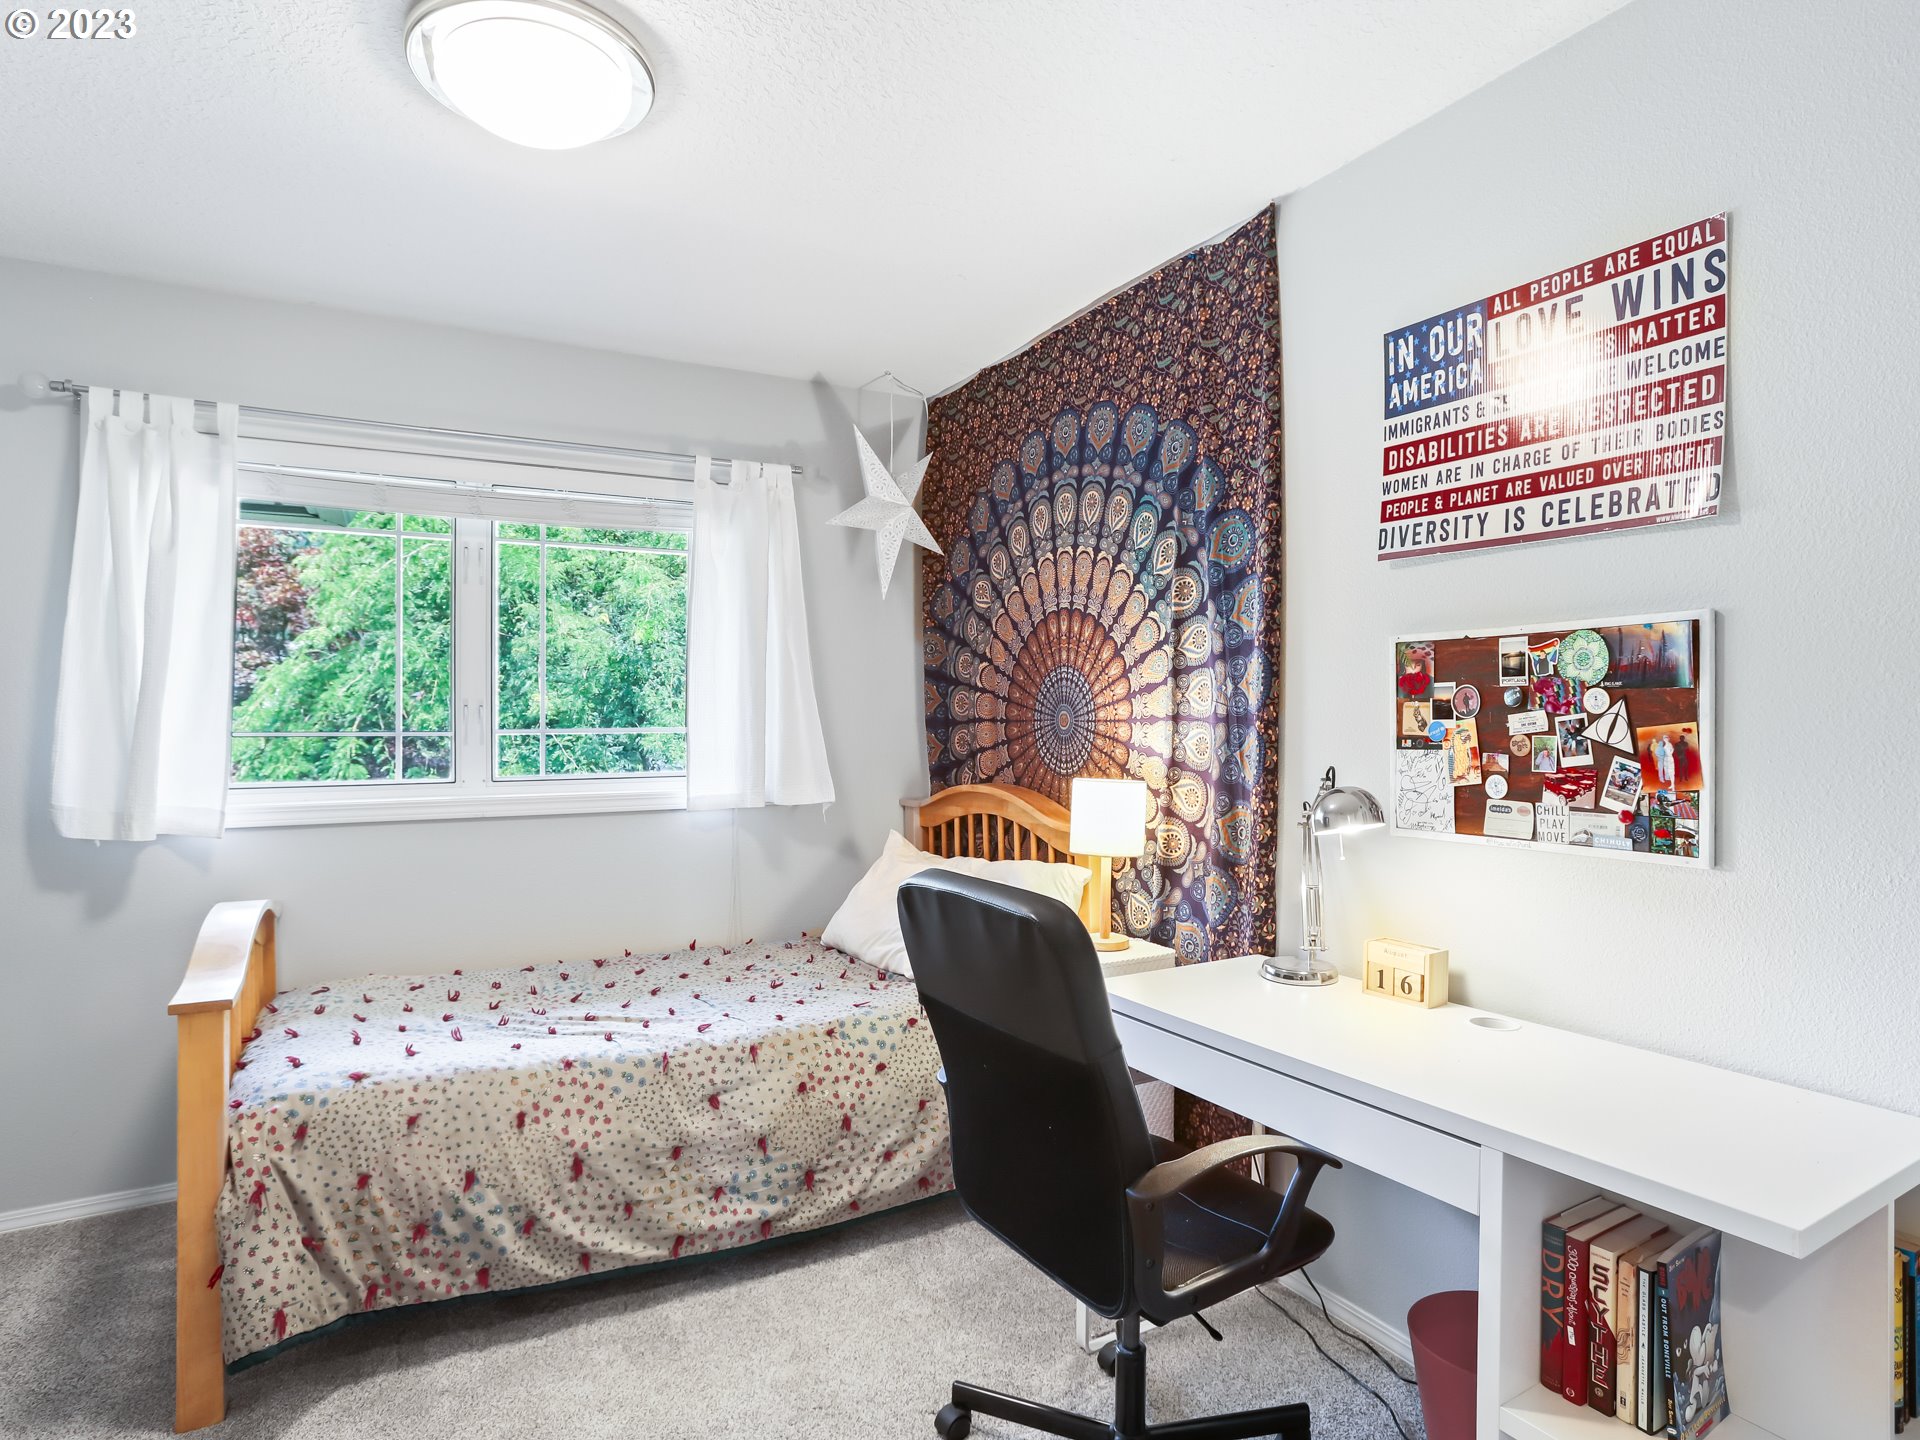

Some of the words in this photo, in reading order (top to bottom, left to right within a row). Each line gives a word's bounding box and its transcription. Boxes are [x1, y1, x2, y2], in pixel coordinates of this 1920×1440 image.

[1493, 291, 1520, 314] ALL
[1530, 264, 1594, 301] PEOPLE
[1605, 248, 1640, 276] ARE
[1652, 222, 1716, 260] EQUAL
[1611, 248, 1725, 322] WINS
[1389, 334, 1415, 376] IN
[1429, 312, 1483, 362] OUR
[1628, 304, 1716, 348] MATTER
[1627, 336, 1725, 381] WELCOME
[1389, 358, 1482, 409] AMERICA
[1384, 405, 1469, 442] IMMIGRANTS
[1477, 401, 1485, 418] &
[1388, 428, 1508, 470] DISABILITIES
[1520, 412, 1560, 442] ARE
[1382, 473, 1428, 496] WOMEN
[1436, 466, 1462, 485] ARE
[1470, 462, 1484, 478] IN
[1492, 447, 1552, 474] CHARGE
[1561, 442, 1580, 461] OF
[1592, 427, 1643, 455] THEIR
[1656, 410, 1724, 441] BODIES
[1386, 496, 1428, 518] PEOPLE
[1434, 495, 1443, 510] &
[1450, 485, 1499, 508] PLANET
[1505, 479, 1532, 498] ARE
[1539, 466, 1595, 491] VALUED
[1602, 456, 1643, 480] OVER
[1654, 443, 1714, 473] PROFIT
[1379, 512, 1489, 551] DIVERSITY
[1504, 507, 1526, 533] IS
[1536, 804, 1569, 816] CHILL.
[1566, 1245, 1580, 1272] 3000
[1542, 1247, 1565, 1328] DRY
[1660, 1298, 1668, 1314] OUT
[1590, 1262, 1611, 1389] SCYTHE
[1661, 1315, 1669, 1337] FROM
[1663, 1340, 1672, 1378] BONEVILLE
